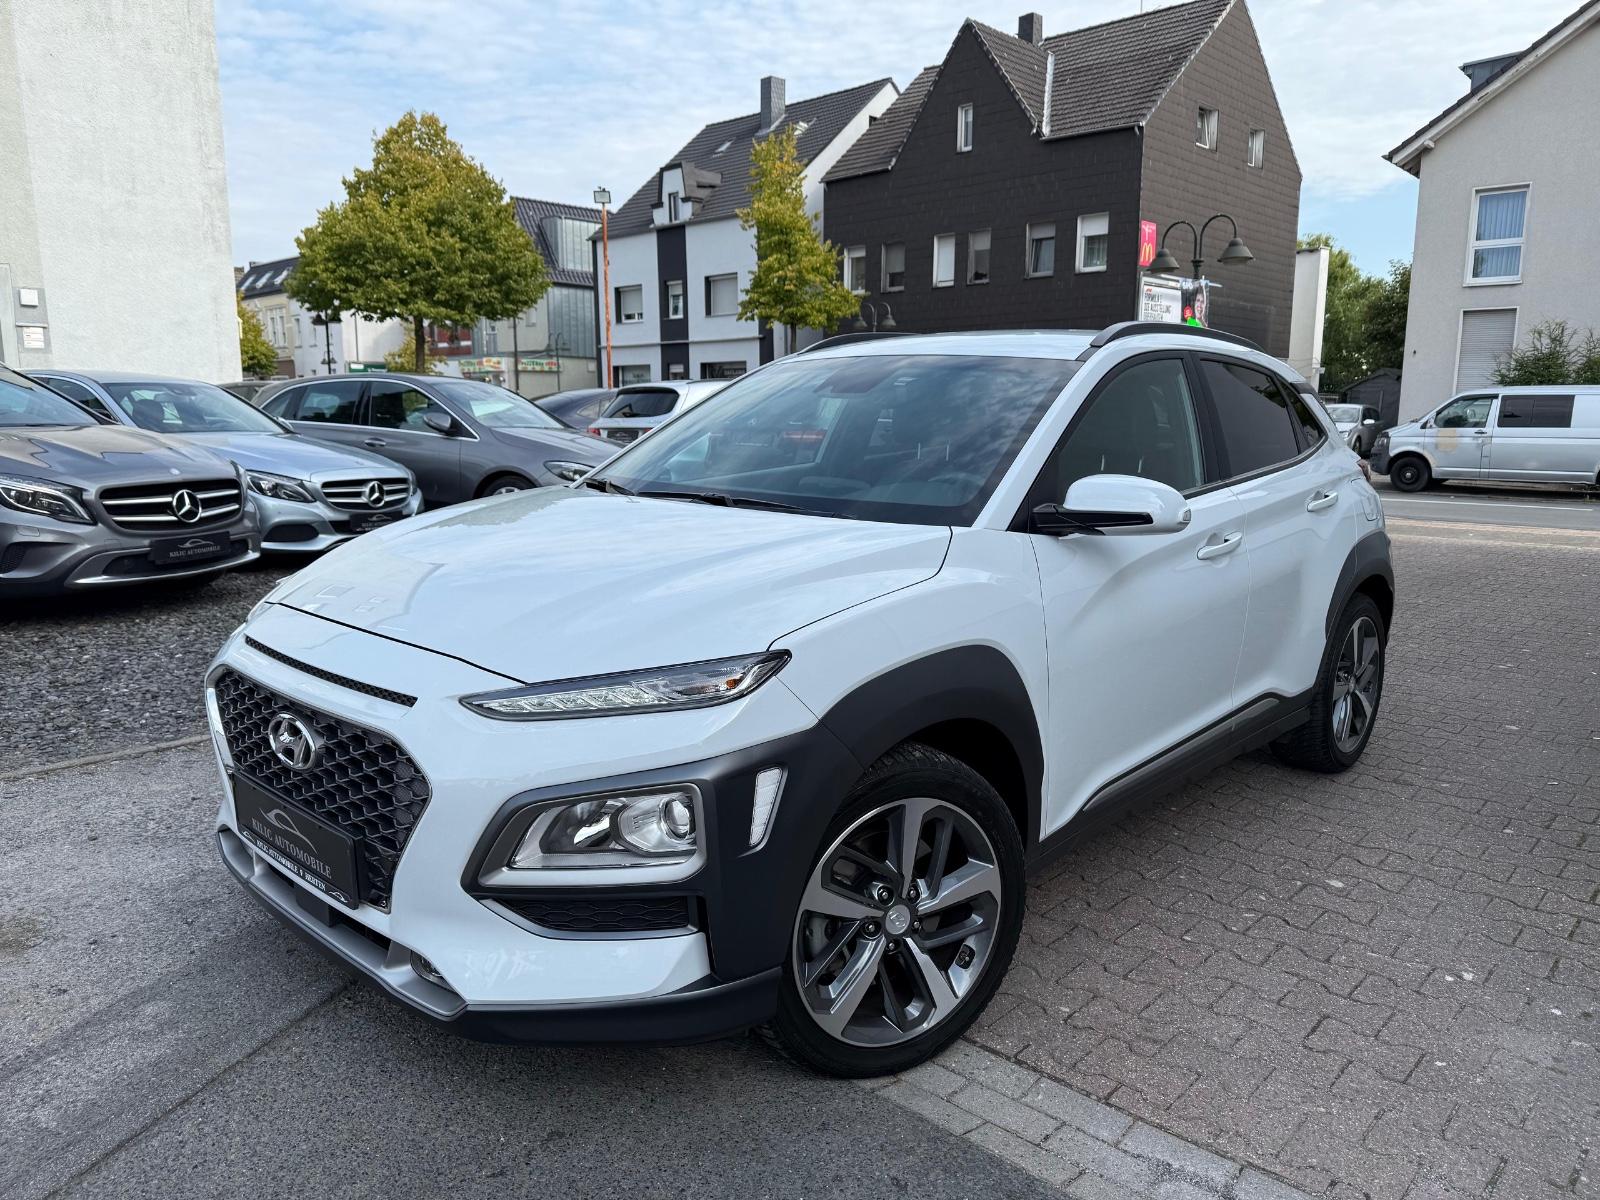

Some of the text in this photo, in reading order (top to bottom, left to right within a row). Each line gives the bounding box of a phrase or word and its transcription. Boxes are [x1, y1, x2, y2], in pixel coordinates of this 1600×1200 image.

[1144, 292, 1160, 302] FORMULA
[1151, 303, 1172, 314] AUSSTELLUNG
[187, 545, 220, 555] AUTOMOBILE
[251, 817, 332, 879] KILIC AUTOMOBILE
